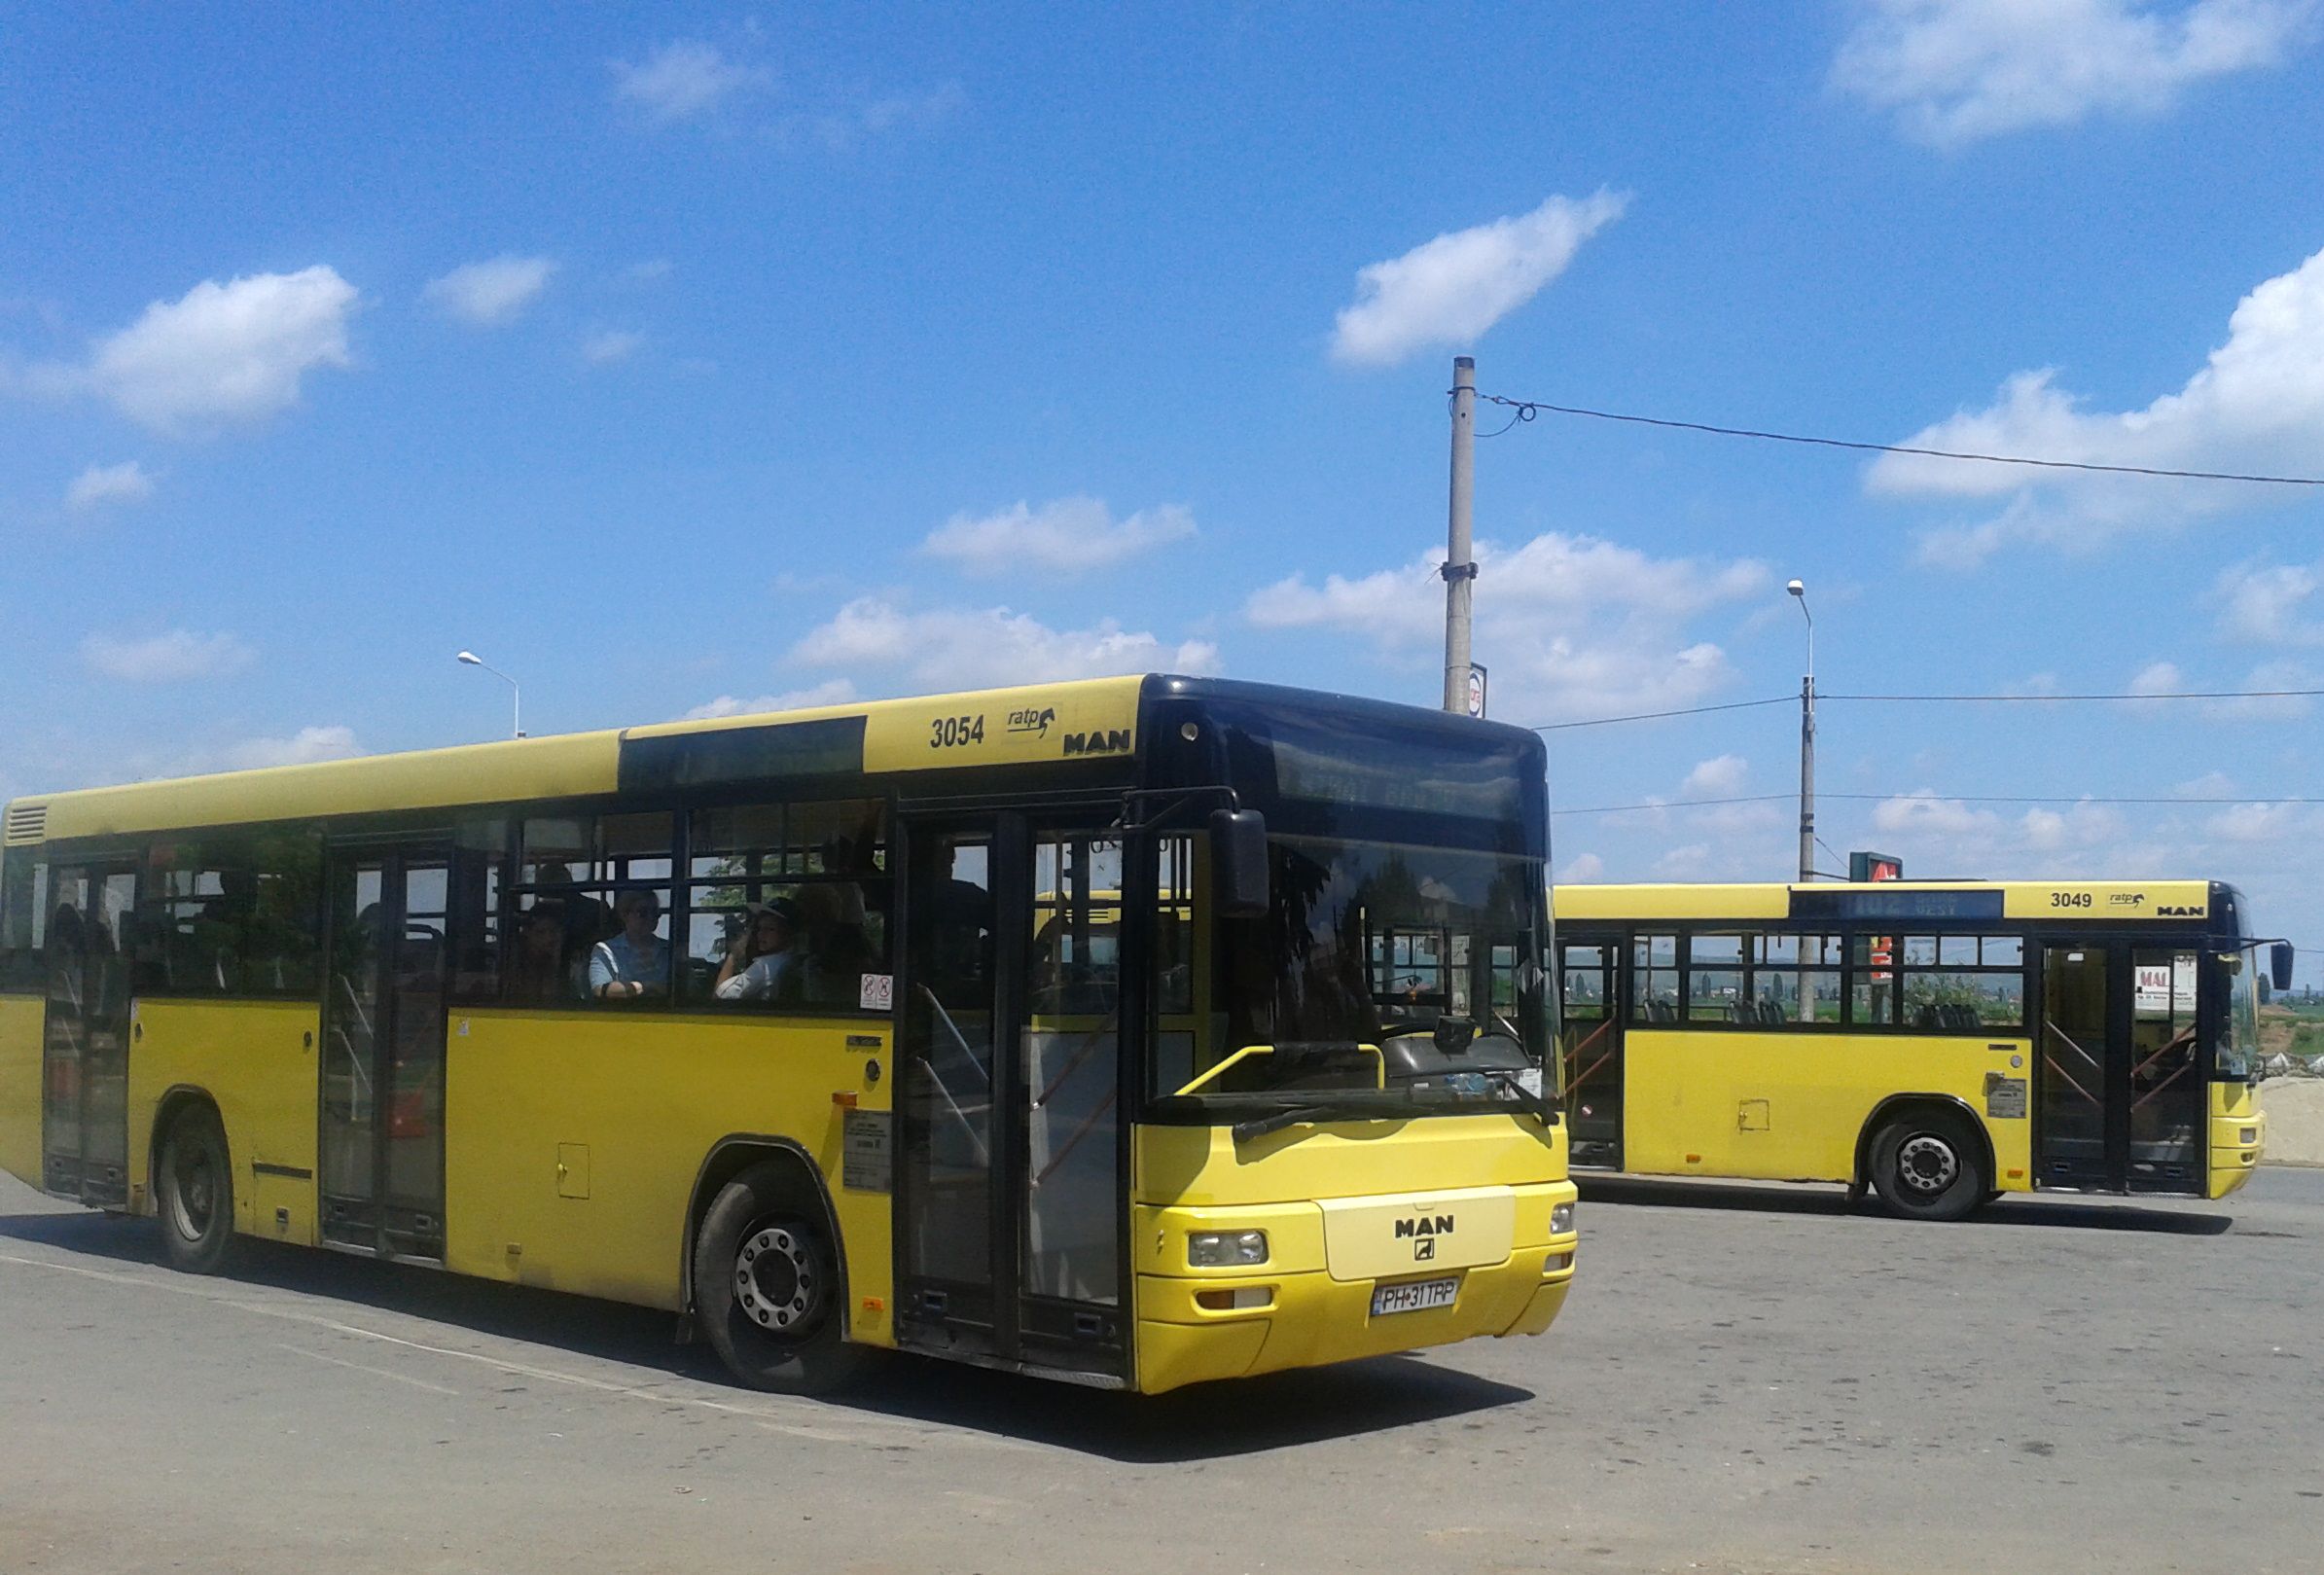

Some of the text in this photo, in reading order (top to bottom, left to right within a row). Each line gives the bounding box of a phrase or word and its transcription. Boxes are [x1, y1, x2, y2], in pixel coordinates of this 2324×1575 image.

[1008, 707, 1039, 728] ratp
[931, 715, 983, 748] 3054
[1063, 730, 1130, 756] MAN
[2051, 892, 2092, 908] 3049
[2109, 893, 2133, 904] ratp
[2157, 906, 2205, 916] MAN
[1397, 1215, 1454, 1238] MAN
